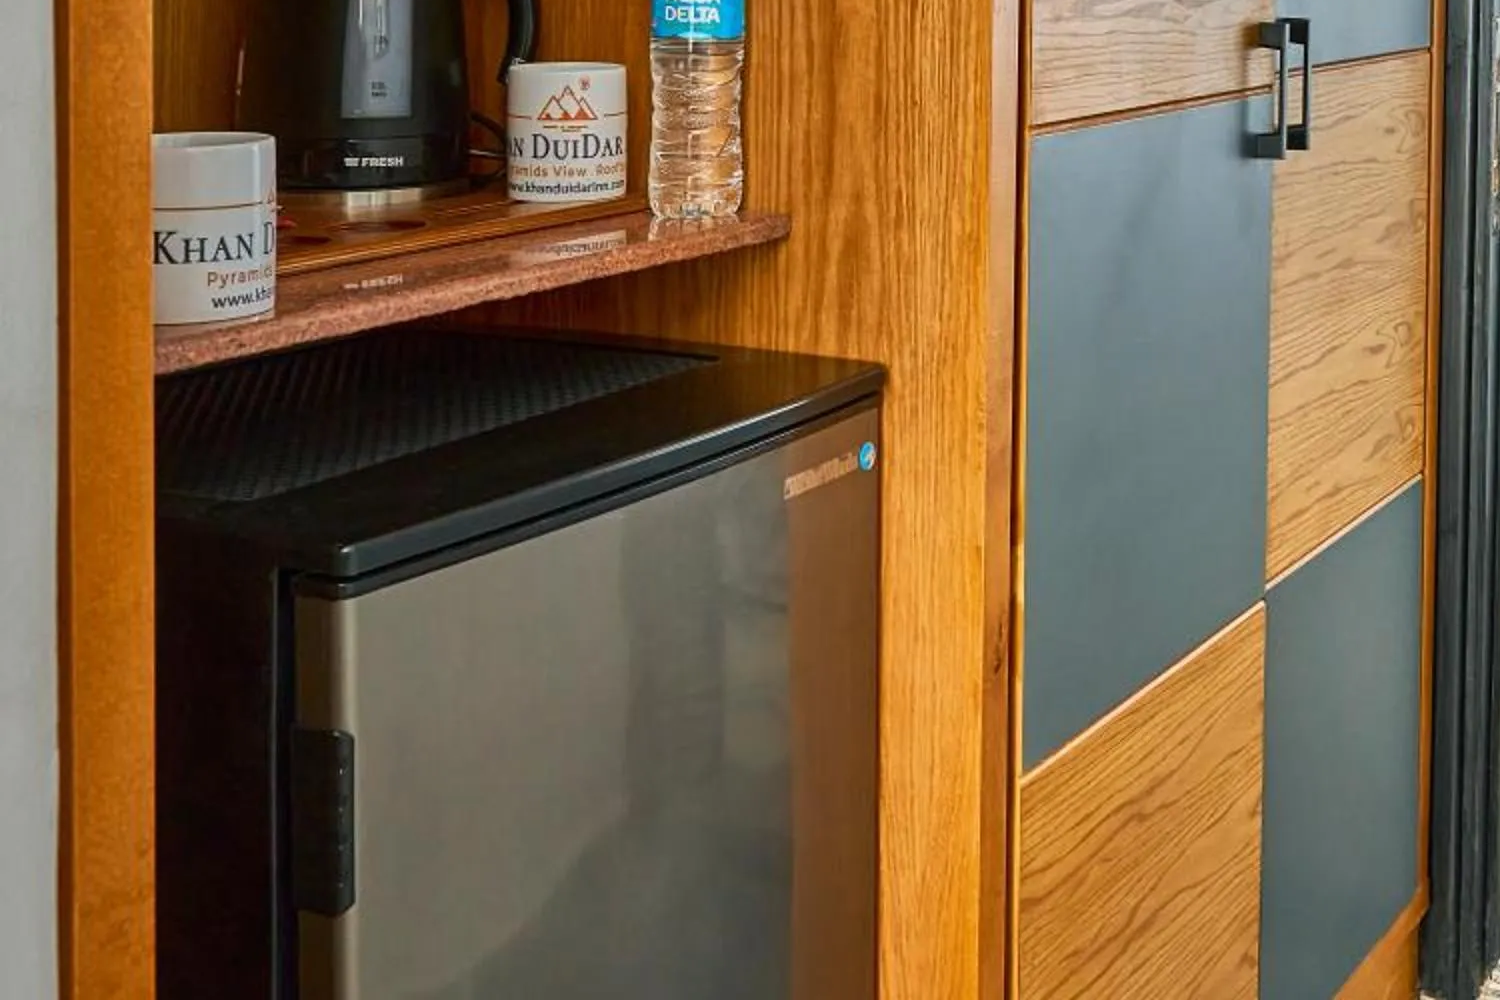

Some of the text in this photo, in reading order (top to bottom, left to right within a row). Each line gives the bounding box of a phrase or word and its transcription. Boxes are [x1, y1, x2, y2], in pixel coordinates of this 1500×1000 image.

[665, 5, 721, 24] DELTA
[361, 156, 404, 168] FRESH
[552, 163, 588, 178] View
[153, 230, 255, 265] KHAN
